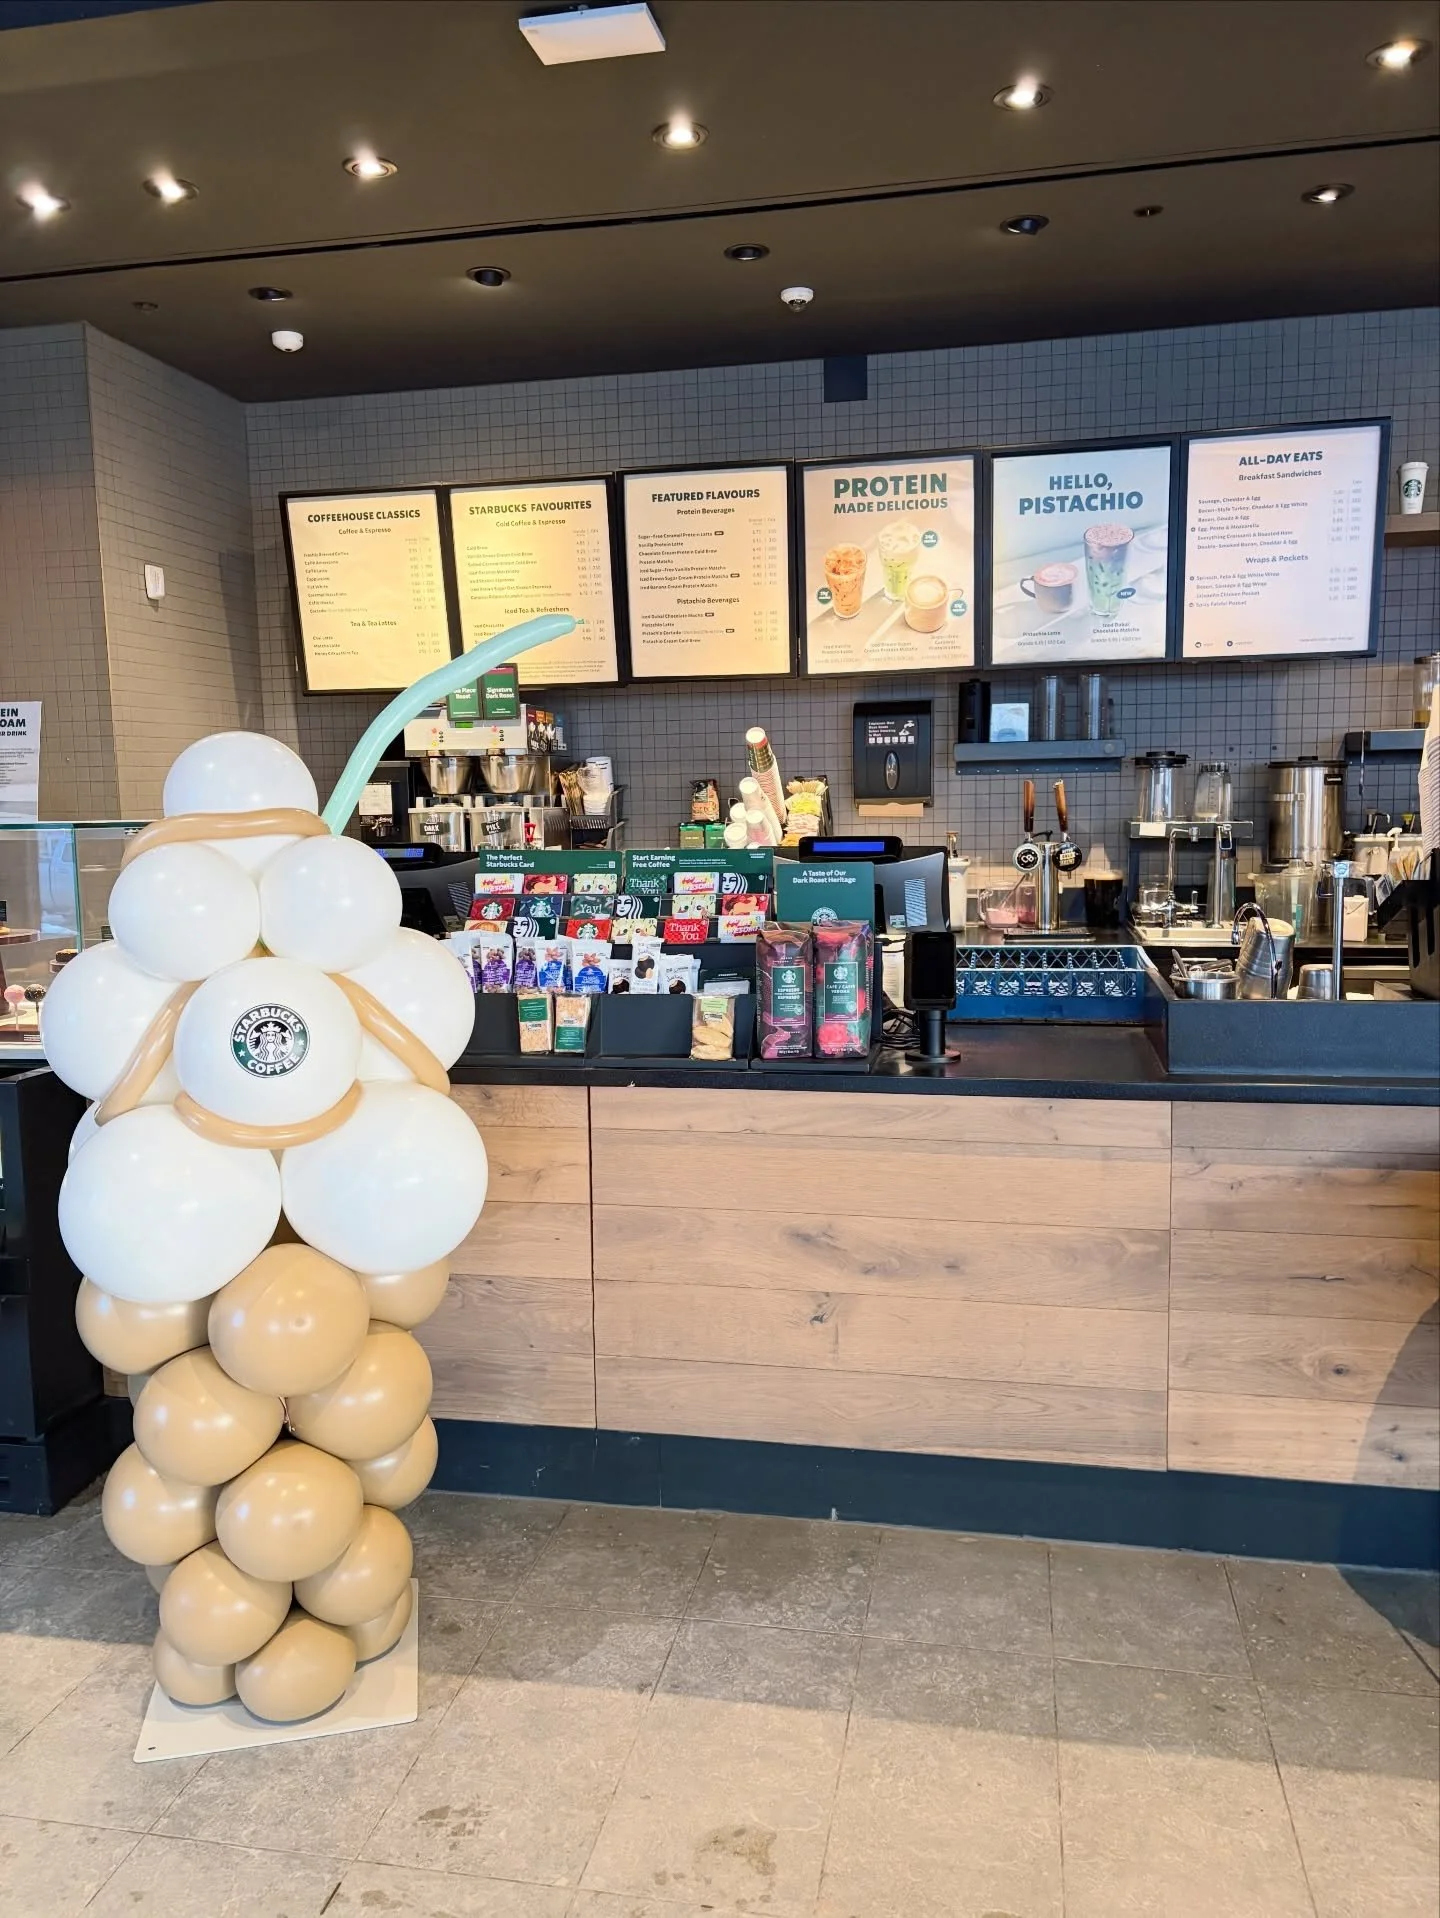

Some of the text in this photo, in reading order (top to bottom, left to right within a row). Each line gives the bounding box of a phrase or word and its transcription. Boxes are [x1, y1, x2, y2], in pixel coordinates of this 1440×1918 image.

[1239, 451, 1322, 466] ALL-DAY EATS
[1050, 473, 1112, 490] HELLO,
[1239, 470, 1321, 481] Breakfast Sandwiches
[834, 473, 947, 498] PROTEIN
[652, 489, 760, 502] FEATURED FLAVOURS
[469, 500, 591, 515] STARBUCKS FAVOURITES
[834, 498, 947, 514] MADE DELICIOUS
[1019, 491, 1143, 515] PISTACHIO
[308, 510, 420, 522] COFFEEHOUSE CLASSICS
[1246, 556, 1270, 564] Wraps
[650, 854, 675, 862] Earning
[630, 878, 659, 888] Thank
[828, 876, 856, 884] Heritage
[641, 886, 659, 894] You
[580, 904, 601, 914] Yay!
[670, 923, 700, 931] Thank
[681, 931, 700, 940] You
[234, 1008, 303, 1042] STARBUCKS
[247, 1053, 300, 1074] COFFEE
